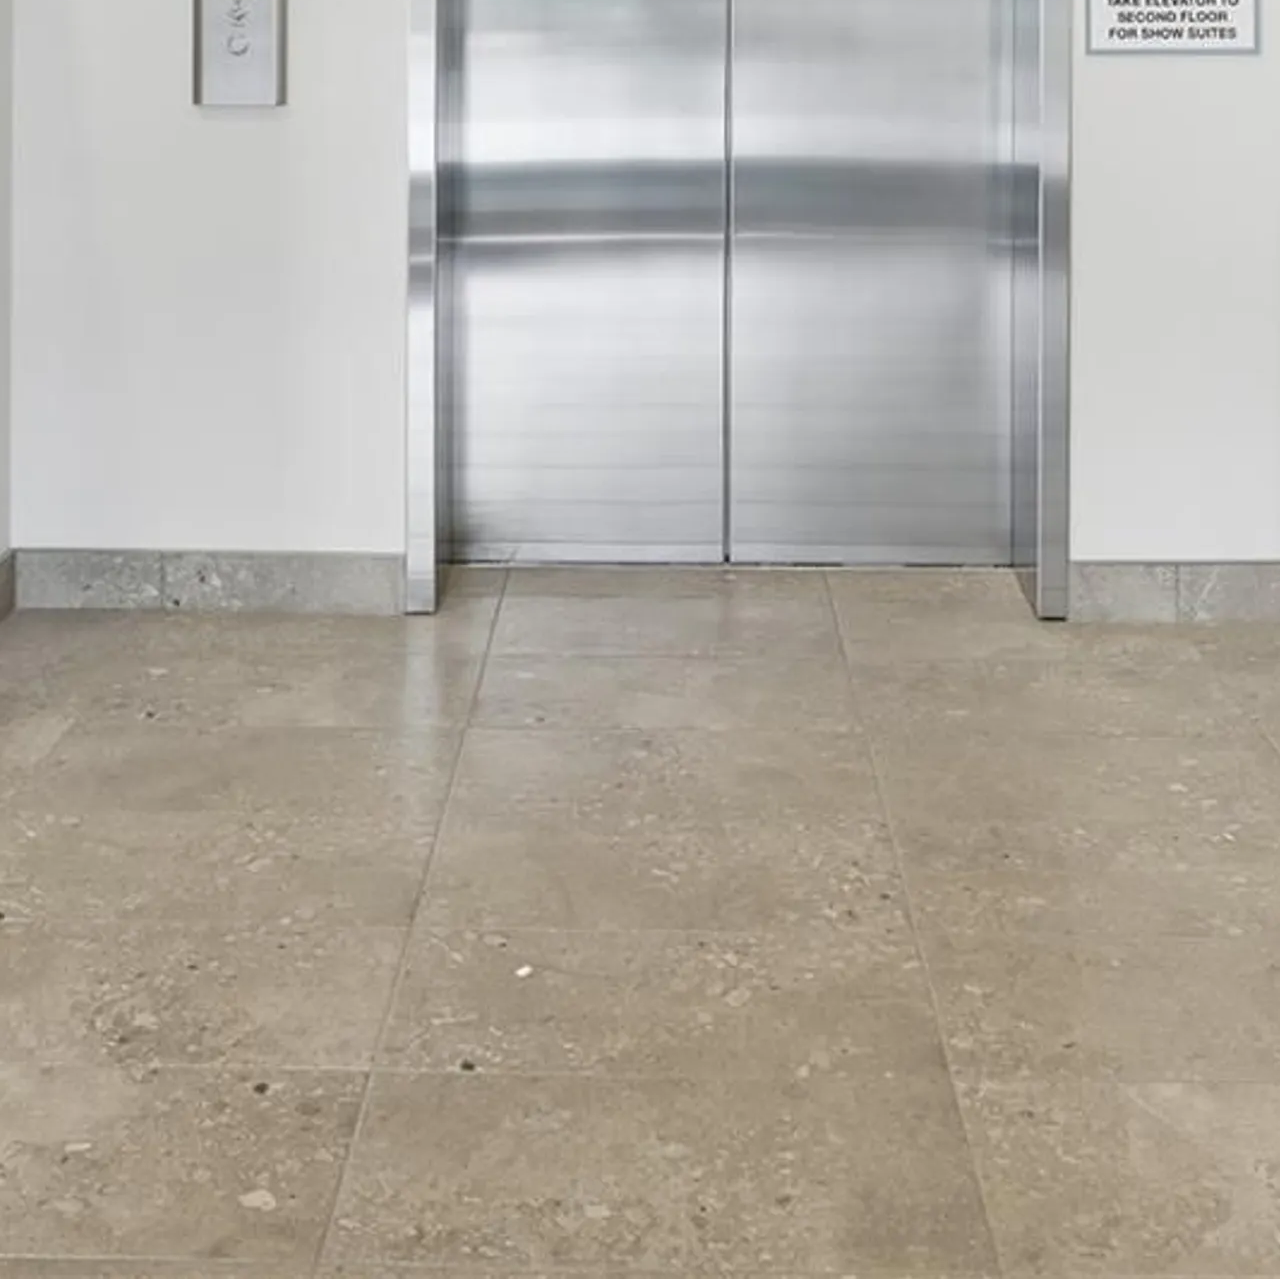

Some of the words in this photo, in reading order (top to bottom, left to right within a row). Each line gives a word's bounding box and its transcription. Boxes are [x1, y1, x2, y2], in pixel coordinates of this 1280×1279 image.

[1117, 11, 1176, 23] SECOND
[1180, 11, 1228, 23] FLOOR
[1108, 27, 1137, 40] FOR
[1141, 27, 1184, 40] SHOW
[1187, 27, 1237, 40] SUITES
